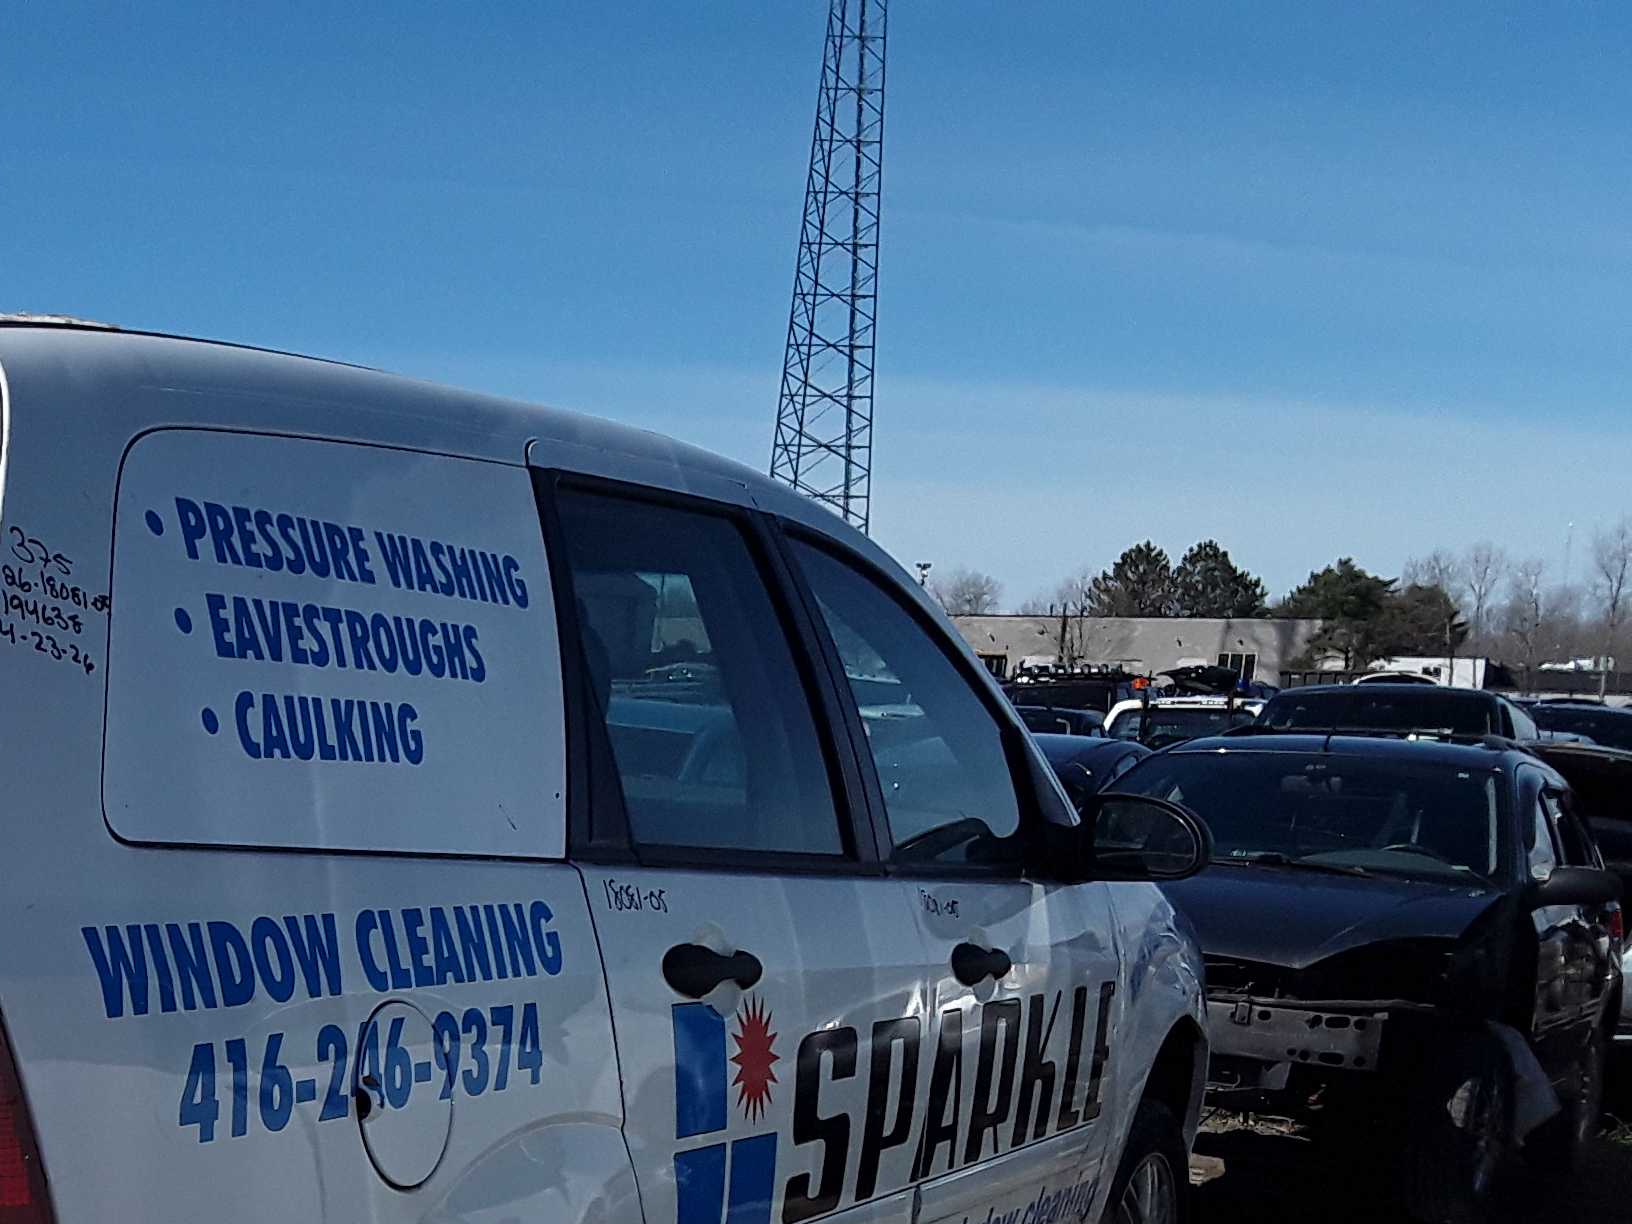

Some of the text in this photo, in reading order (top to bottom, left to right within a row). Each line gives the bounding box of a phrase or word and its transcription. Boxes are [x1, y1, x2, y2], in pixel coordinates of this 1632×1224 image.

[175, 497, 529, 609] PRESSURE WASHING
[206, 592, 487, 683] EAVESTROUGHS
[234, 691, 424, 765] CAULKING
[82, 901, 562, 1019] WINDOW CLEANING
[178, 1002, 543, 1143] 416-246-9374
